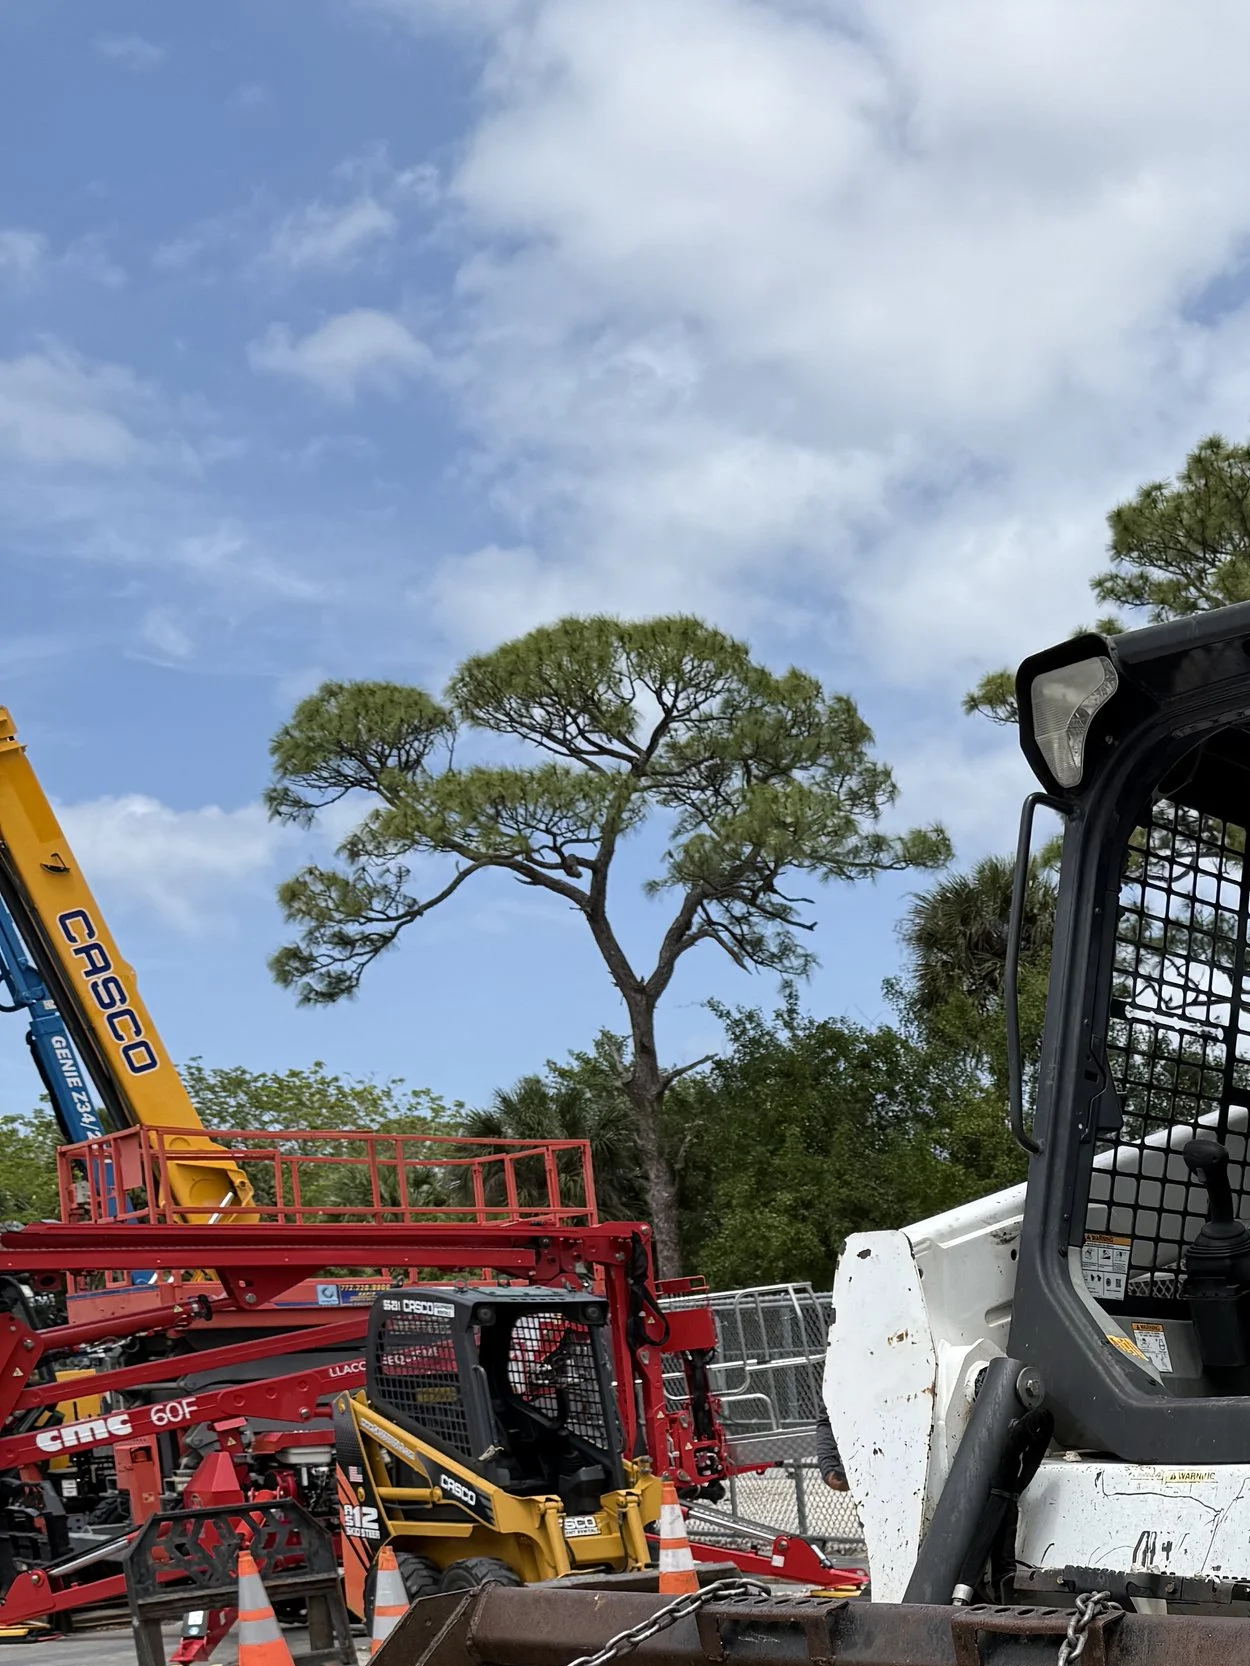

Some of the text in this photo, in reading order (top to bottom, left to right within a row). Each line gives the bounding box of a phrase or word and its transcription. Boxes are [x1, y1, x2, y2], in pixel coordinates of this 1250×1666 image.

[57, 908, 160, 1077] CASCO
[50, 1035, 82, 1088] GENIE
[403, 1299, 434, 1315] CASCO
[36, 1397, 199, 1453] cmc 60F
[440, 1473, 477, 1507] CASCO
